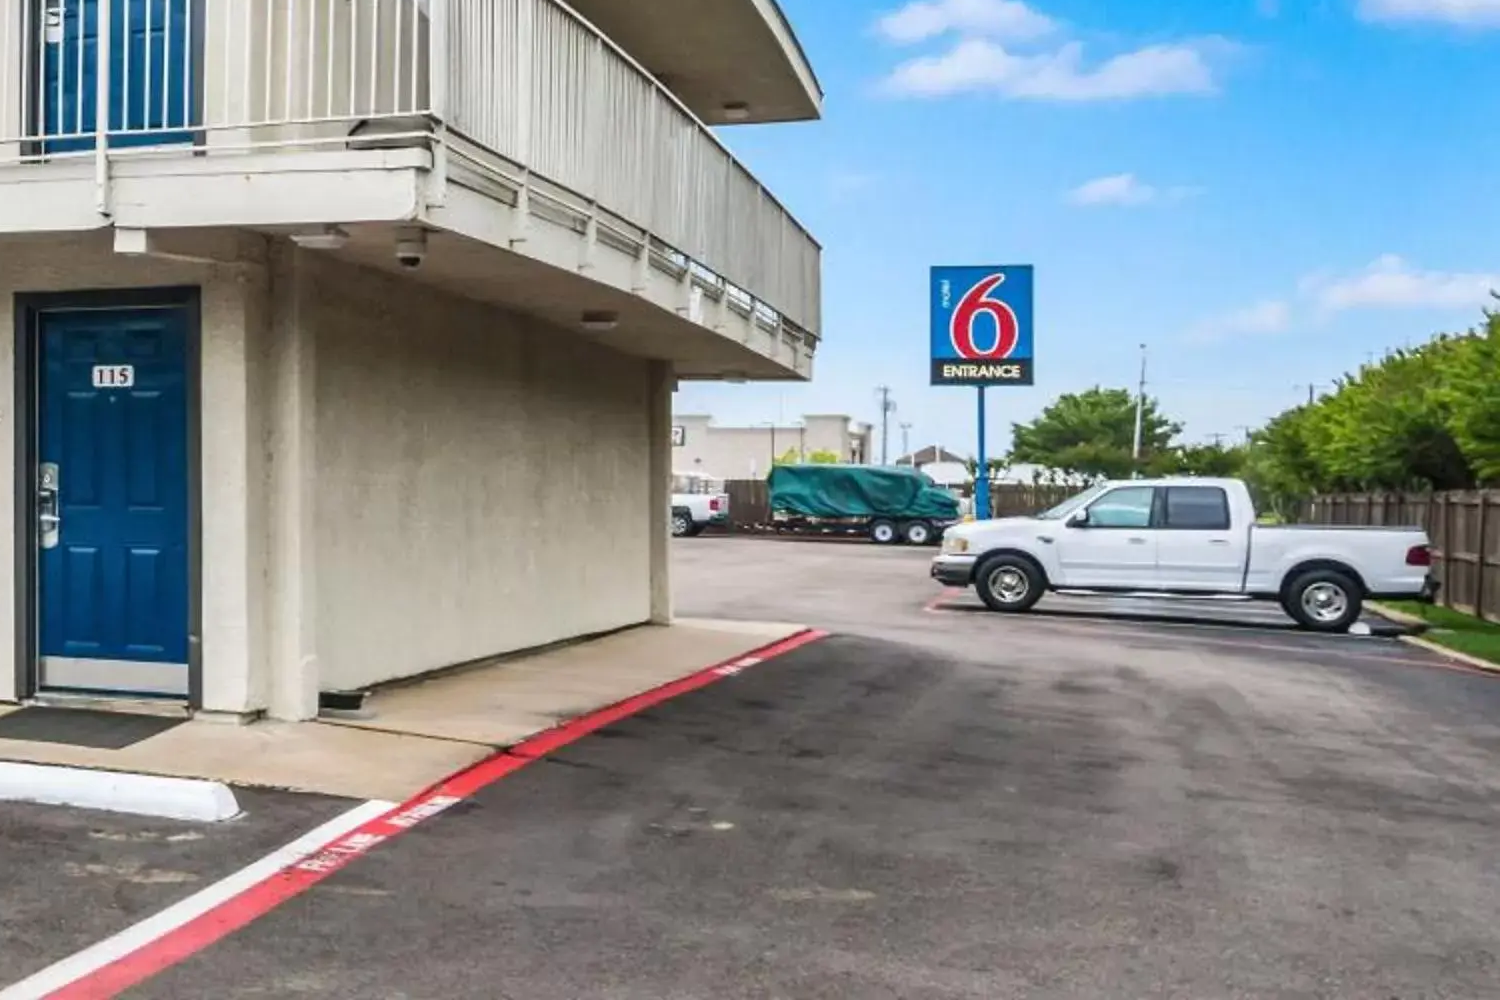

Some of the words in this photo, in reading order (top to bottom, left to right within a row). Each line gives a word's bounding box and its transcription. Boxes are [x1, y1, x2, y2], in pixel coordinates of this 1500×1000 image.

[949, 273, 1019, 359] 6
[97, 367, 129, 385] 115
[943, 365, 1021, 378] ENTRANCE
